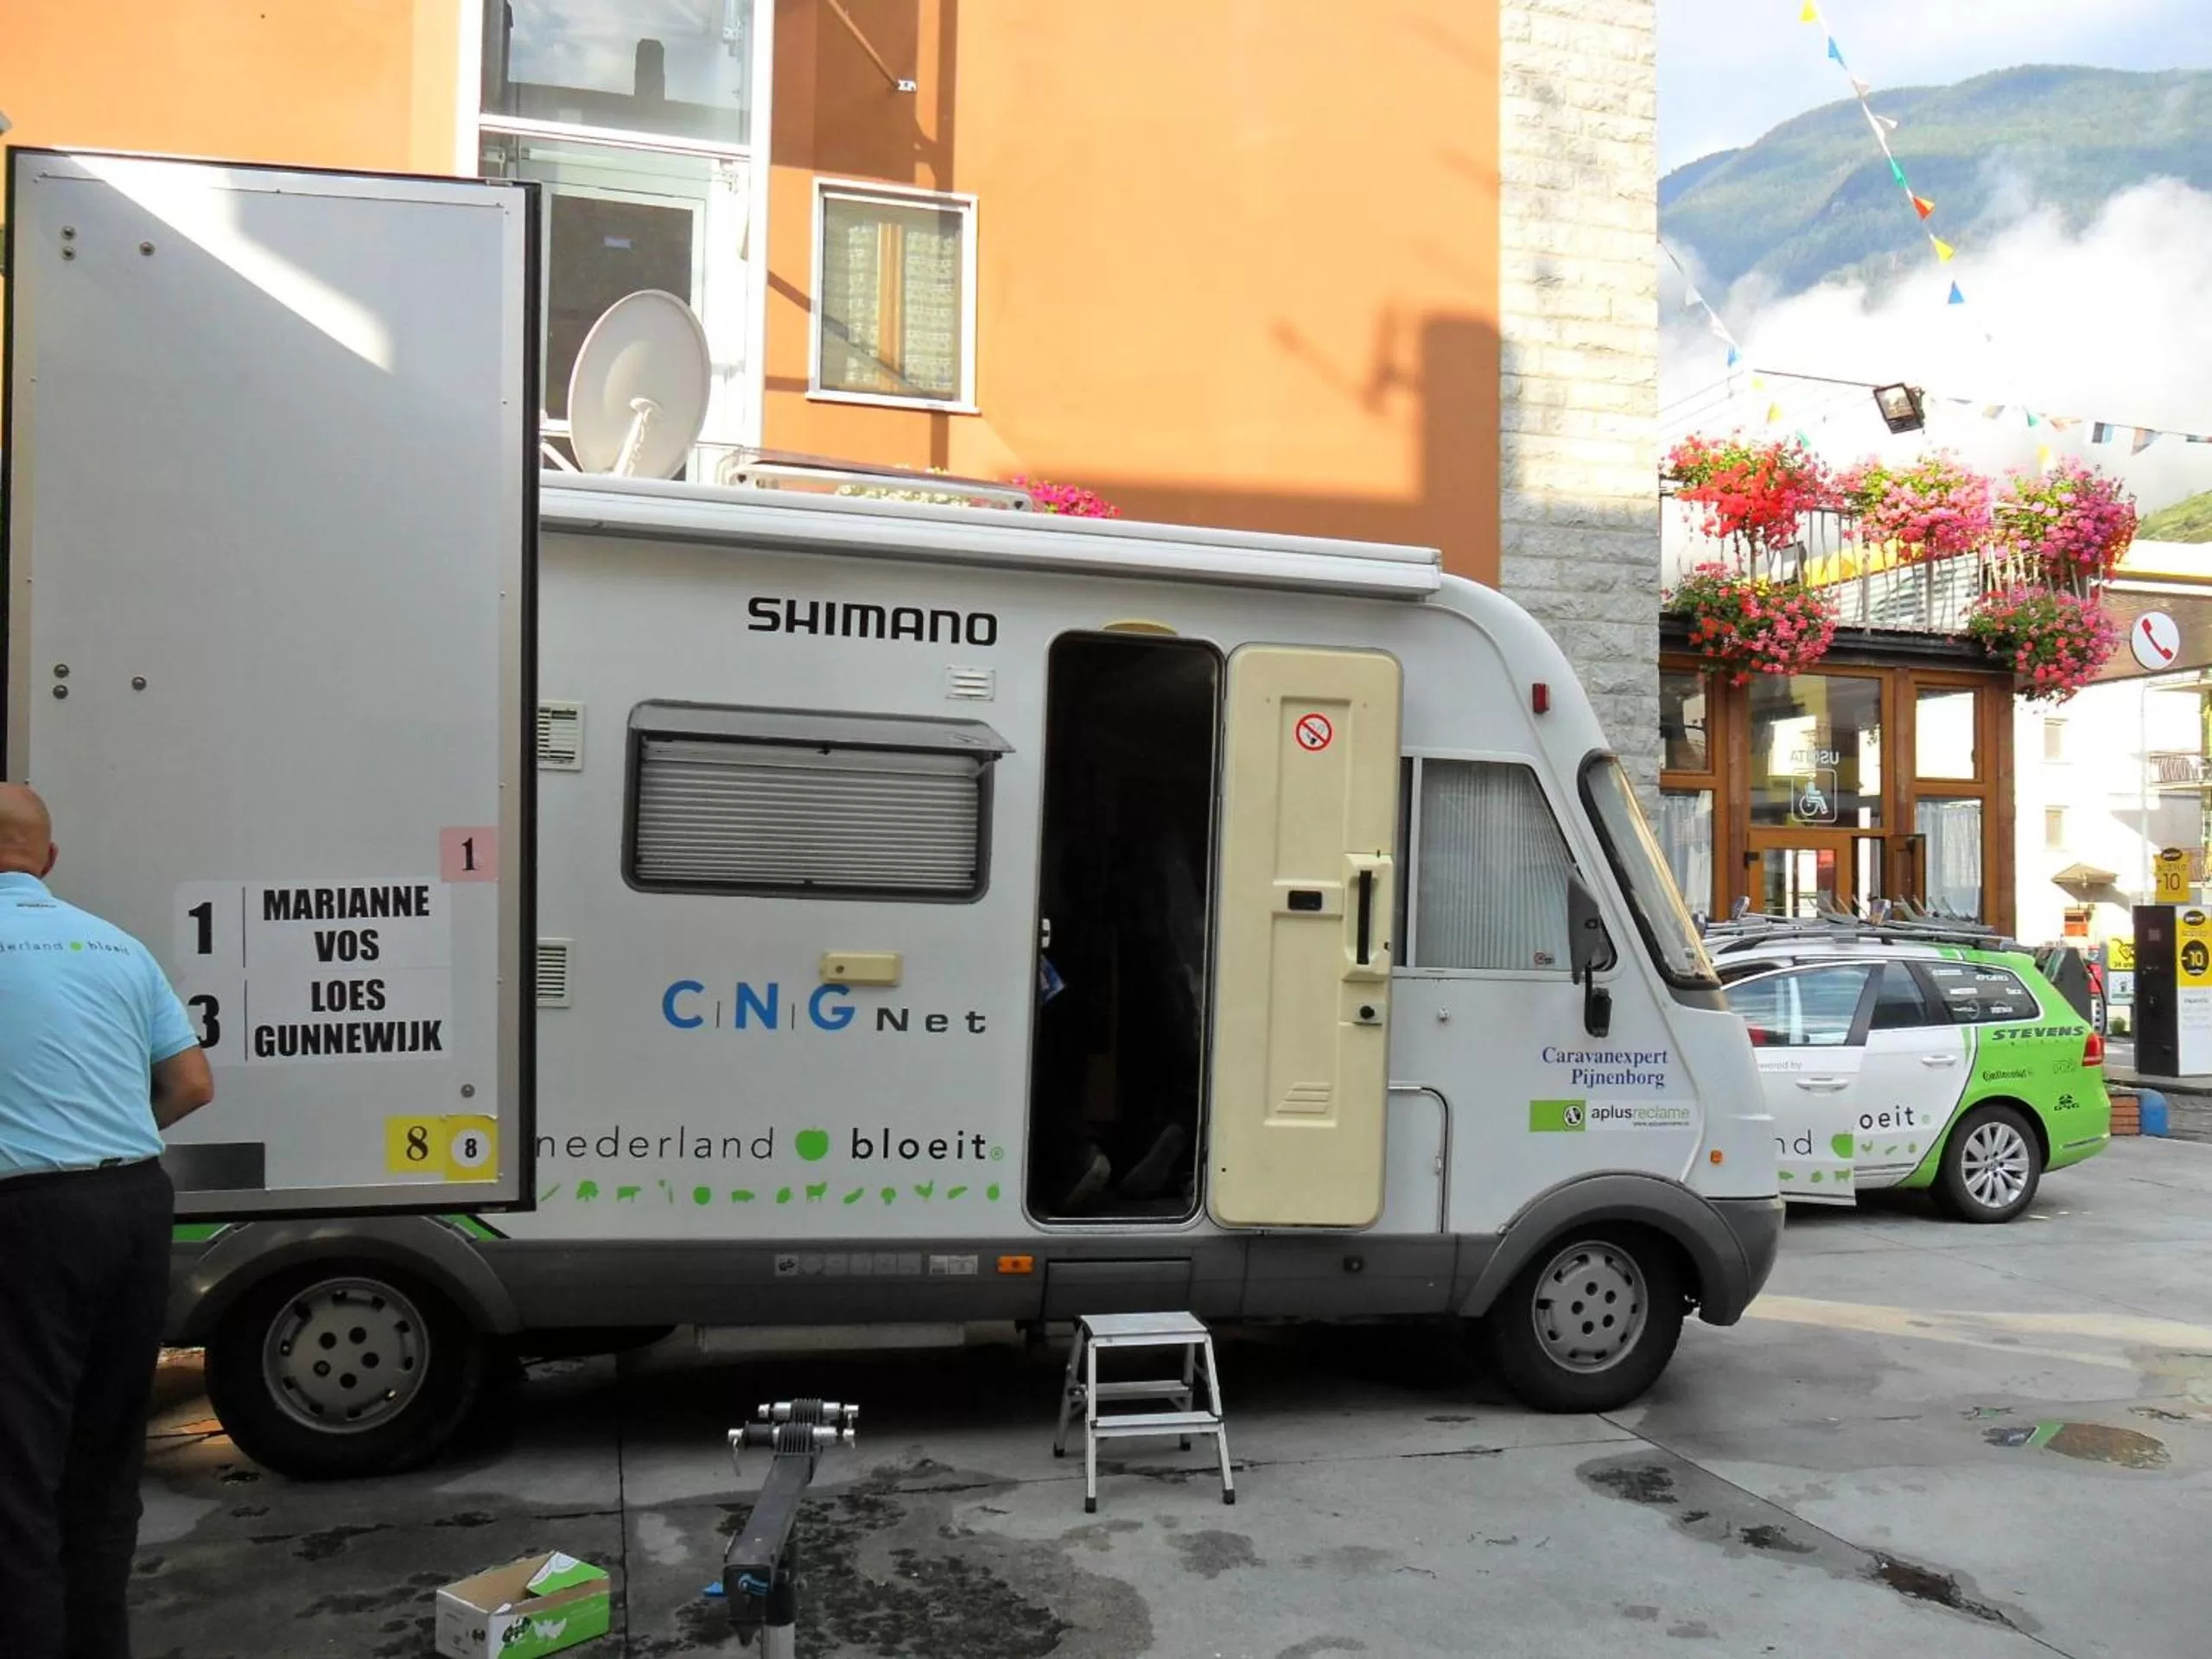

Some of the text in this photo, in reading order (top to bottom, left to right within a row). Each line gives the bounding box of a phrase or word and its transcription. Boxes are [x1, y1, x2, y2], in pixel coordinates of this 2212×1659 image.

[747, 597, 998, 646] SHIMANO
[461, 836, 477, 871] 1
[263, 885, 430, 921] MARIANNE
[188, 901, 213, 955] 1
[315, 929, 380, 963] VOS
[311, 979, 386, 1013] LOES
[188, 995, 221, 1048] 3
[874, 1007, 987, 1034] Net
[1992, 1026, 2085, 1040] STEVENS
[254, 1020, 443, 1058] GUNNEWIJK
[1541, 1046, 1669, 1065] Caravanexpert
[1570, 1068, 1666, 1089] Pijnenborg
[1591, 1104, 1690, 1122] aplusreclame
[1859, 1105, 1916, 1130] oeit
[405, 1126, 429, 1161] 8
[463, 1139, 478, 1158] 8
[536, 1125, 986, 1160] nederland bloeit
